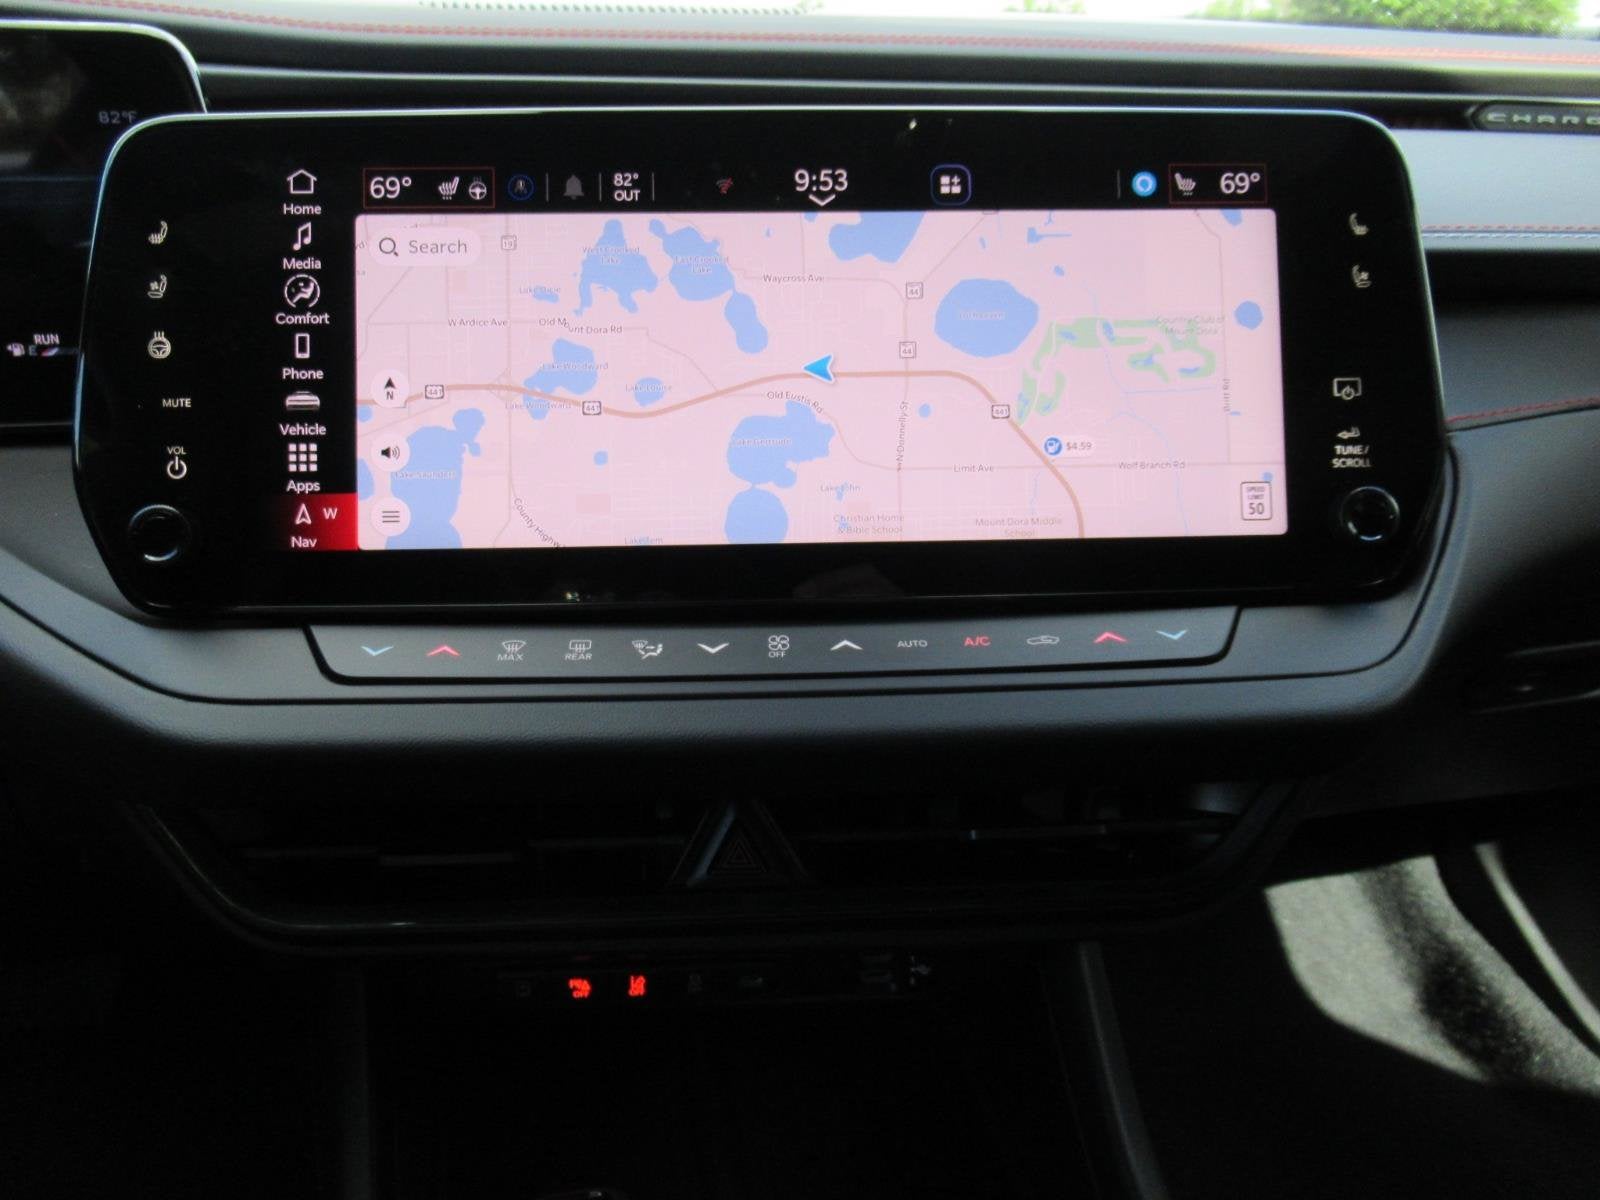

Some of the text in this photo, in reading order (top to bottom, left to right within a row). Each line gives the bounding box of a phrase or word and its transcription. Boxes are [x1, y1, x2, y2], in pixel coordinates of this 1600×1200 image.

[99, 111, 137, 124] 82°F
[613, 172, 639, 187] 82°
[794, 169, 848, 192] 9:53
[1219, 172, 1261, 195] 69°
[370, 176, 412, 199] 69°
[614, 190, 640, 201] OUT
[283, 203, 322, 215] Home
[408, 239, 467, 254] Search
[283, 258, 322, 270] Media
[763, 274, 824, 284] Waycross Ave
[275, 313, 330, 325] Comfort
[448, 318, 508, 327] W Ardice Ave
[538, 317, 556, 327] Old
[586, 325, 608, 334] Dora
[610, 325, 623, 334] Rd
[33, 333, 60, 345] RUN
[282, 367, 324, 379] Phone
[386, 391, 394, 400] N
[162, 398, 192, 408] MUTE
[767, 391, 784, 400] Old
[813, 400, 824, 413] Rd
[279, 424, 327, 435] Vehicle
[167, 446, 186, 455] VOL
[1066, 441, 1092, 451] $4.59
[953, 464, 994, 473] Limit Ave
[1118, 461, 1186, 470] Wolf Branch Rd
[1332, 458, 1371, 468] SCROLL
[286, 480, 320, 493] Apps
[322, 507, 338, 519] W
[513, 497, 537, 529] County
[1249, 502, 1265, 515] 50
[833, 514, 875, 523] Christian
[975, 517, 1003, 526] Mount
[1006, 517, 1029, 526] Dora
[291, 536, 317, 548] Nav
[897, 639, 928, 648] AUTO
[964, 635, 991, 647] A/C
[498, 653, 524, 661] MAX
[564, 652, 593, 661] REAR
[768, 650, 786, 658] OFF
